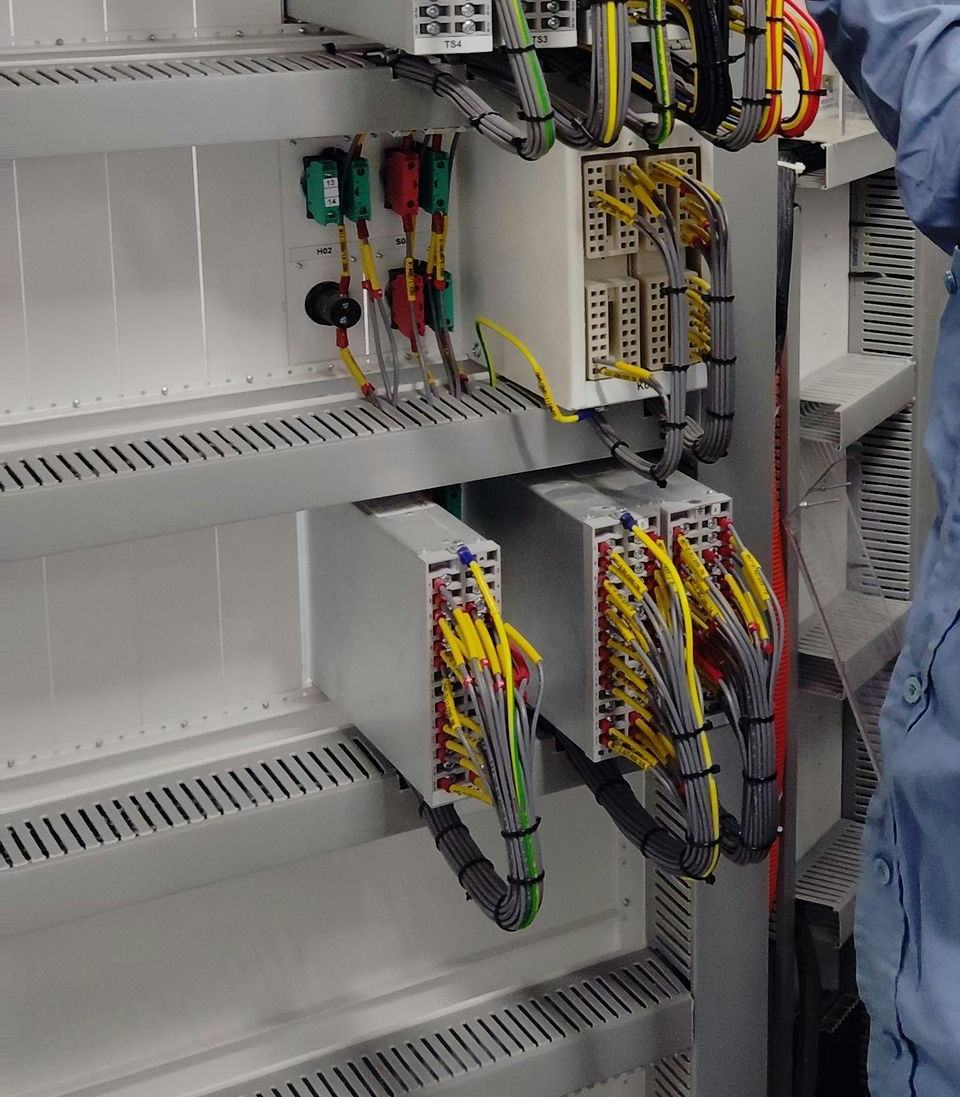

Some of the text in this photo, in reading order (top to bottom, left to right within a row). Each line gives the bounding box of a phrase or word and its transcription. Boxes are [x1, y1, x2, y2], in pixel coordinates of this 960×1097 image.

[532, 35, 548, 44] TS3
[444, 40, 462, 49] TS4
[316, 247, 333, 256] H02
